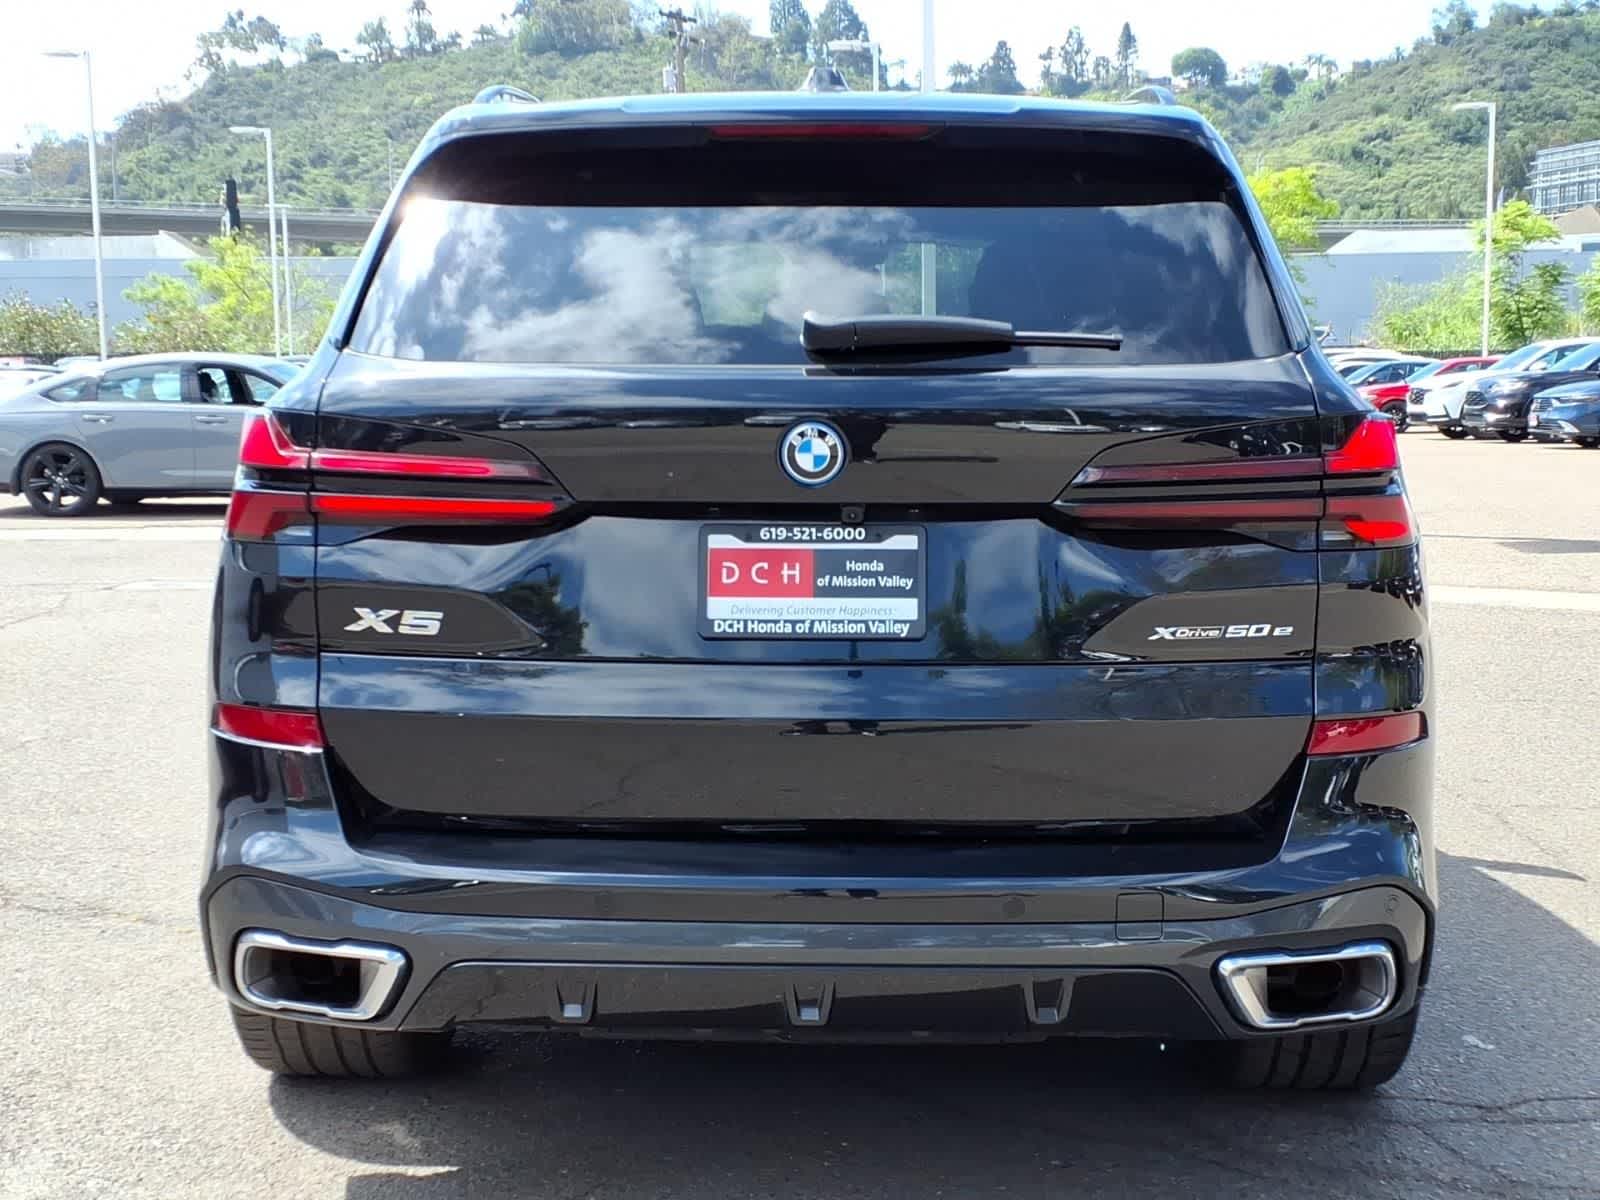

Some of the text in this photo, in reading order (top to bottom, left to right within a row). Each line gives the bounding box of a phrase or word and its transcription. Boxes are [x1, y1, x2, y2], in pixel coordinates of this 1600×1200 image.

[759, 527, 866, 541] 619-521-6000
[846, 560, 884, 572] Honda
[817, 575, 914, 590] of Mission Valley
[730, 604, 784, 619] Delivering
[786, 604, 837, 616] Customer
[343, 607, 444, 635] X5
[713, 620, 910, 637] DCH Honda of Mission Valley
